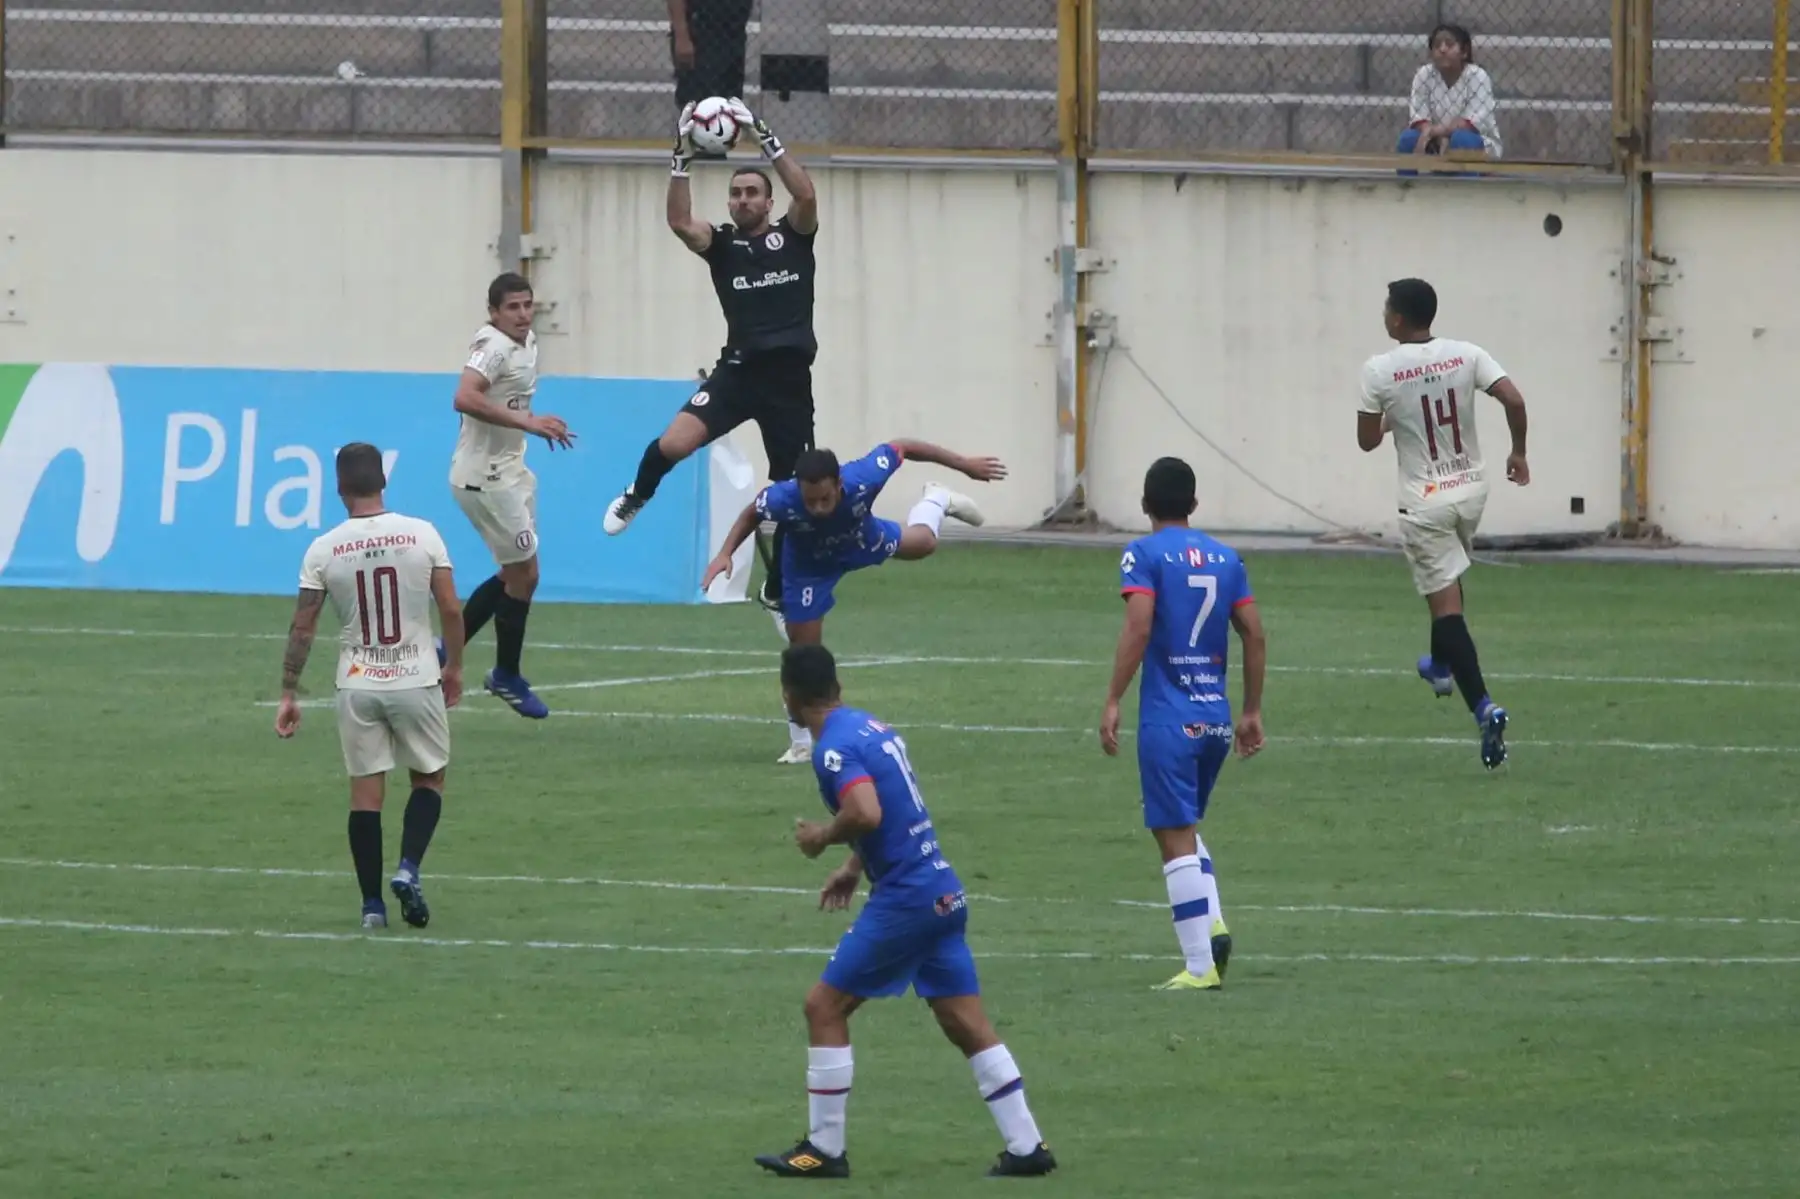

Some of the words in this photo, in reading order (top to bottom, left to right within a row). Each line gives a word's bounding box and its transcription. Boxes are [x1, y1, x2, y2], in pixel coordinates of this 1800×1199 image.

[1393, 357, 1464, 382] MARATHON
[1421, 388, 1463, 461] 14
[333, 535, 416, 556] MARATHON
[365, 550, 385, 559] BET
[356, 567, 401, 645] 10
[802, 587, 813, 606] 8
[1187, 575, 1217, 648] 7
[364, 665, 420, 678] movilbus
